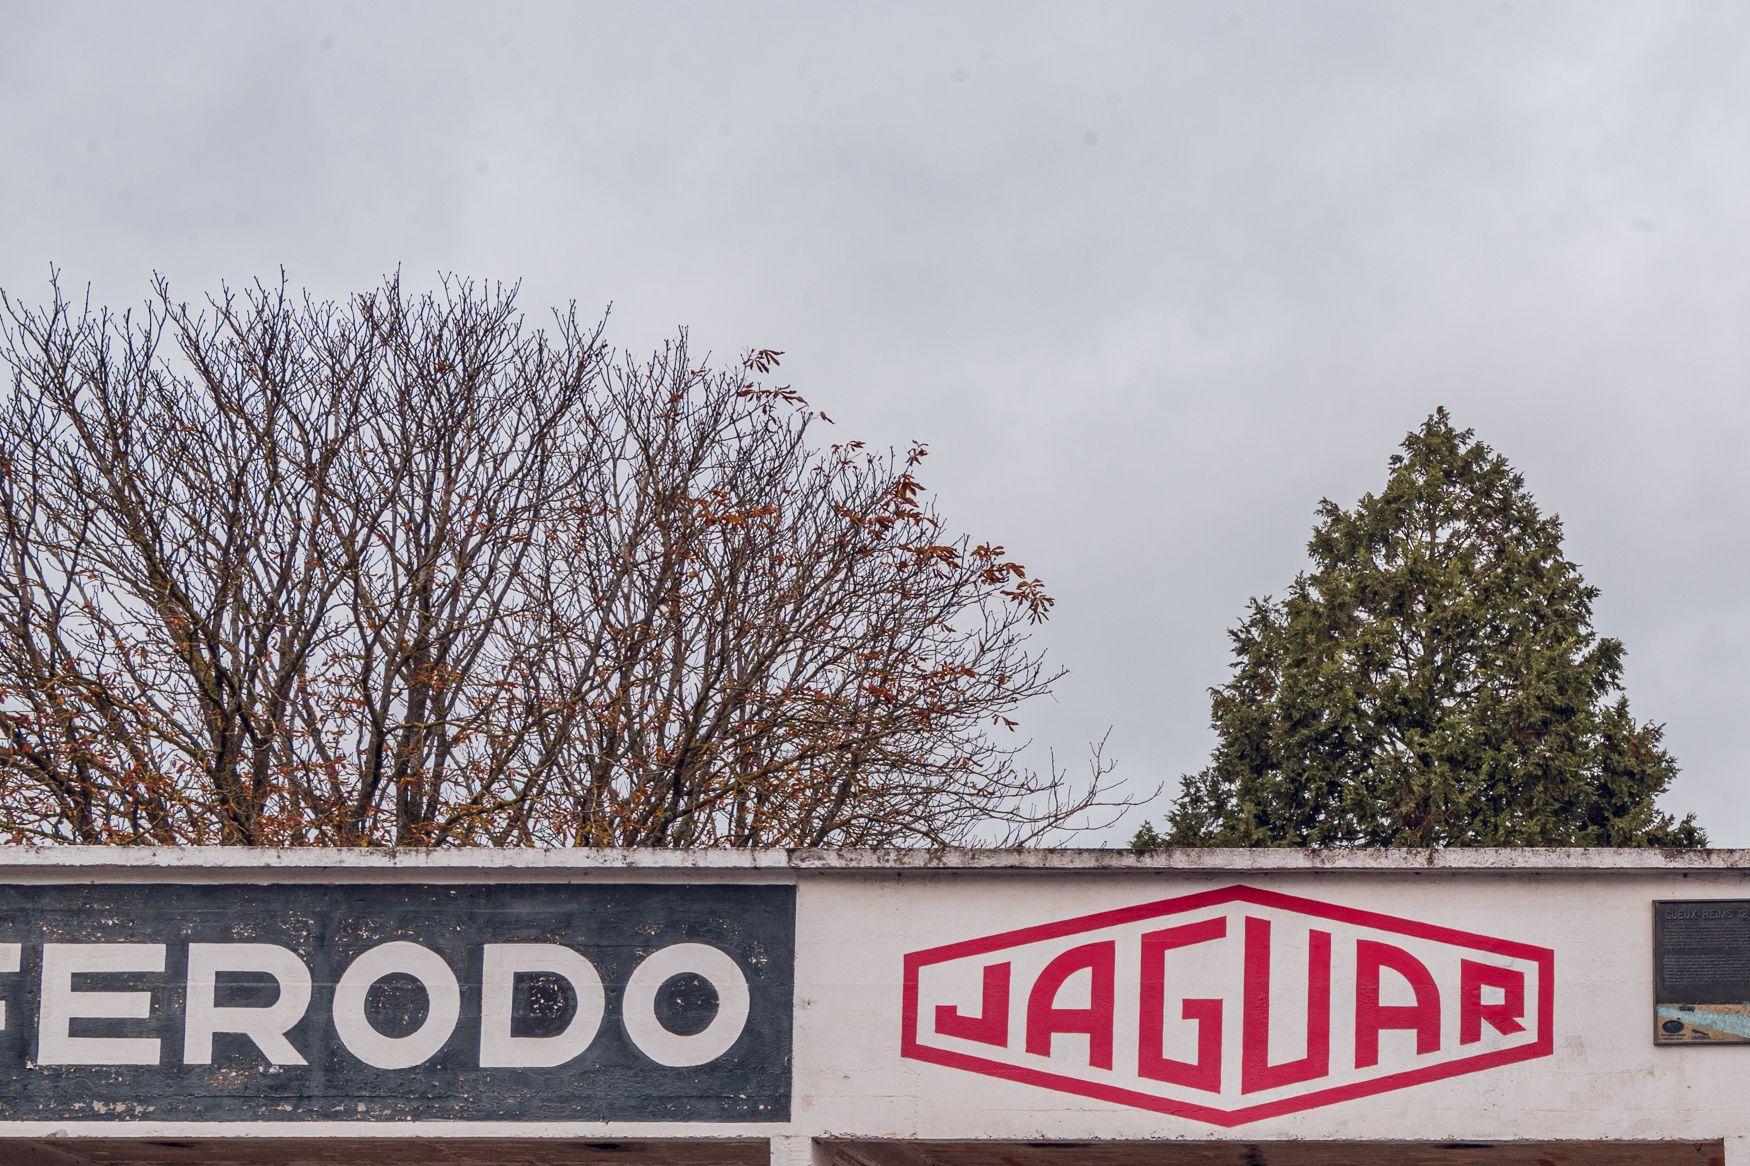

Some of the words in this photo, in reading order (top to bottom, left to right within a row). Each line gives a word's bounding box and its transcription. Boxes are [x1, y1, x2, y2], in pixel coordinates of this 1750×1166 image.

[1738, 908, 1748, 919] 12
[0, 941, 751, 1069] ERODO
[935, 916, 1526, 1095] JAGUAR
